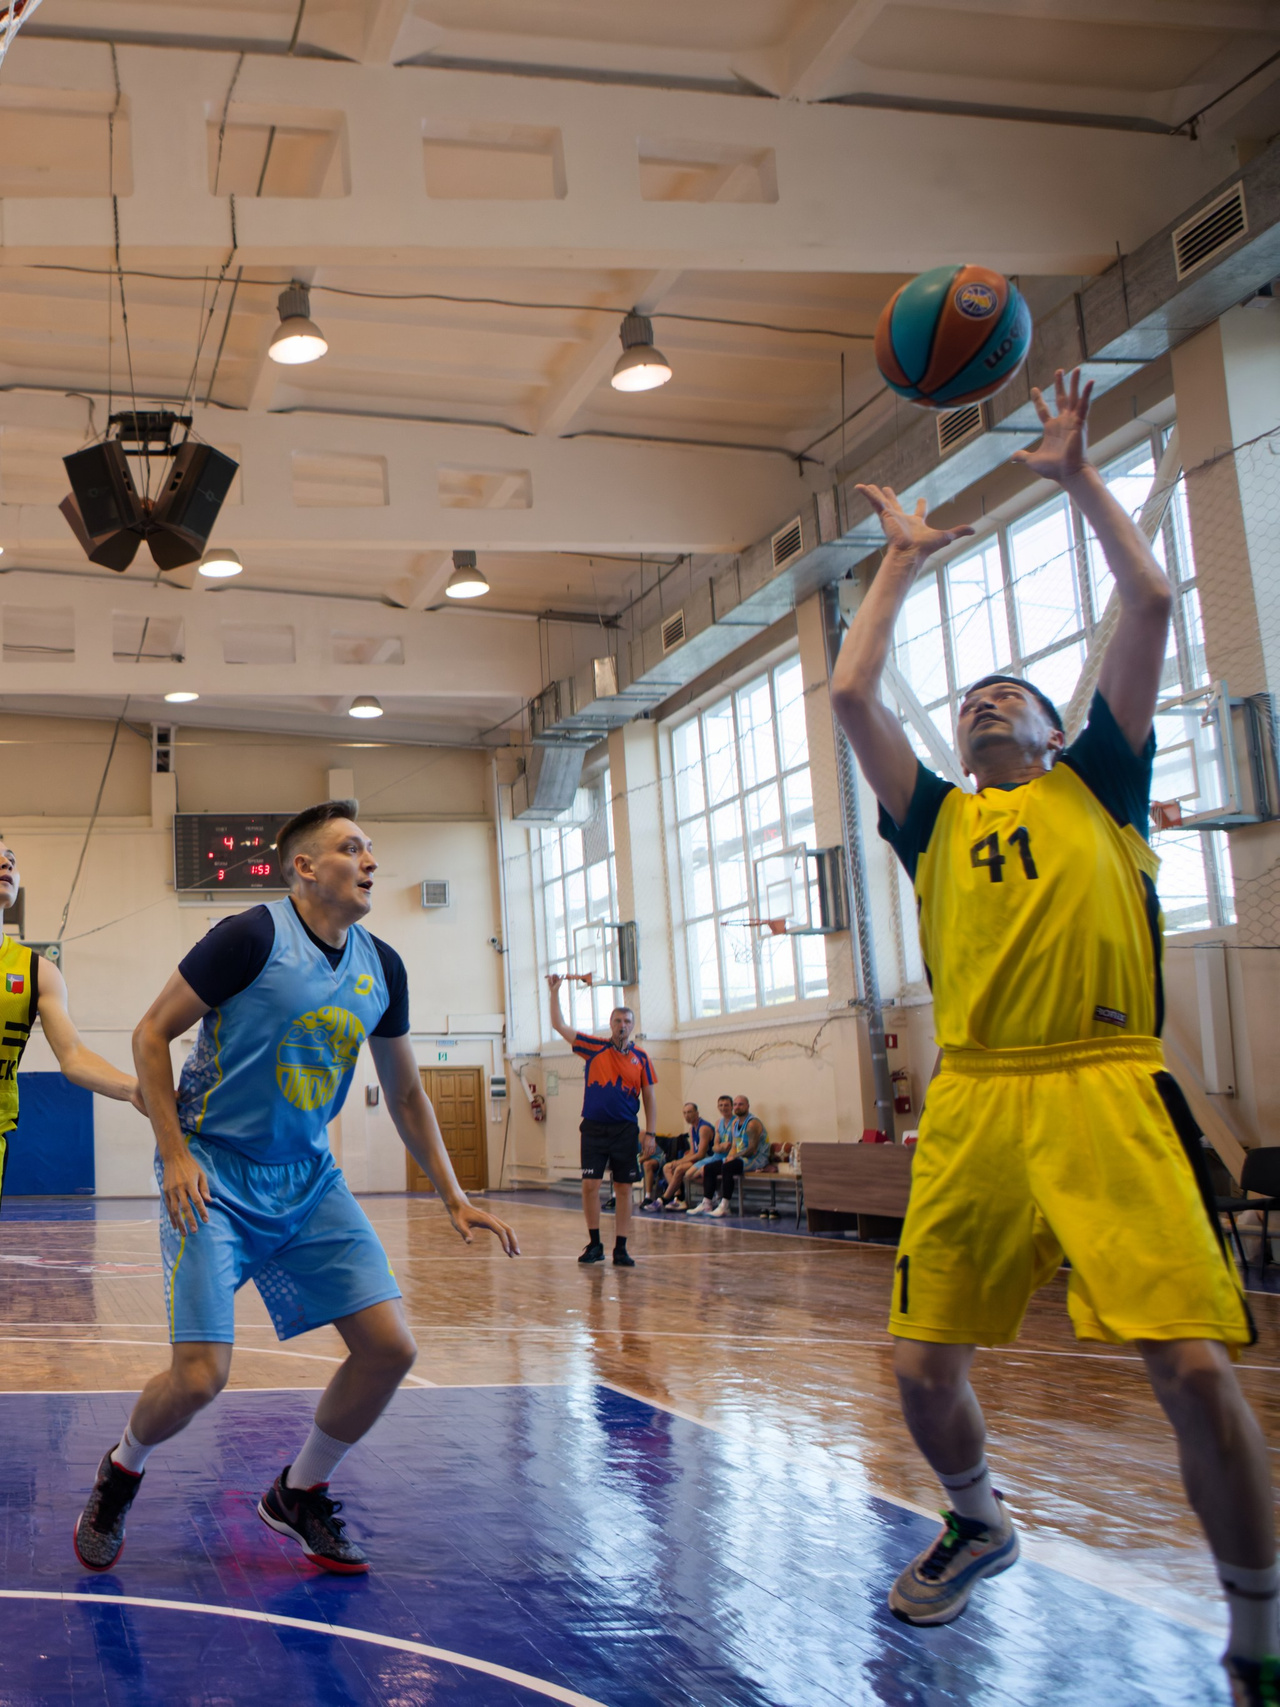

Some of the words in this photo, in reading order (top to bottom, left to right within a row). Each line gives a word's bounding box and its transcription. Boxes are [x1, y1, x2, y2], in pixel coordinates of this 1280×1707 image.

[223, 836, 234, 850] 4
[970, 826, 1039, 883] 41
[218, 869, 225, 881] 3
[251, 864, 270, 875] 1:53
[896, 1254, 909, 1314] 1
